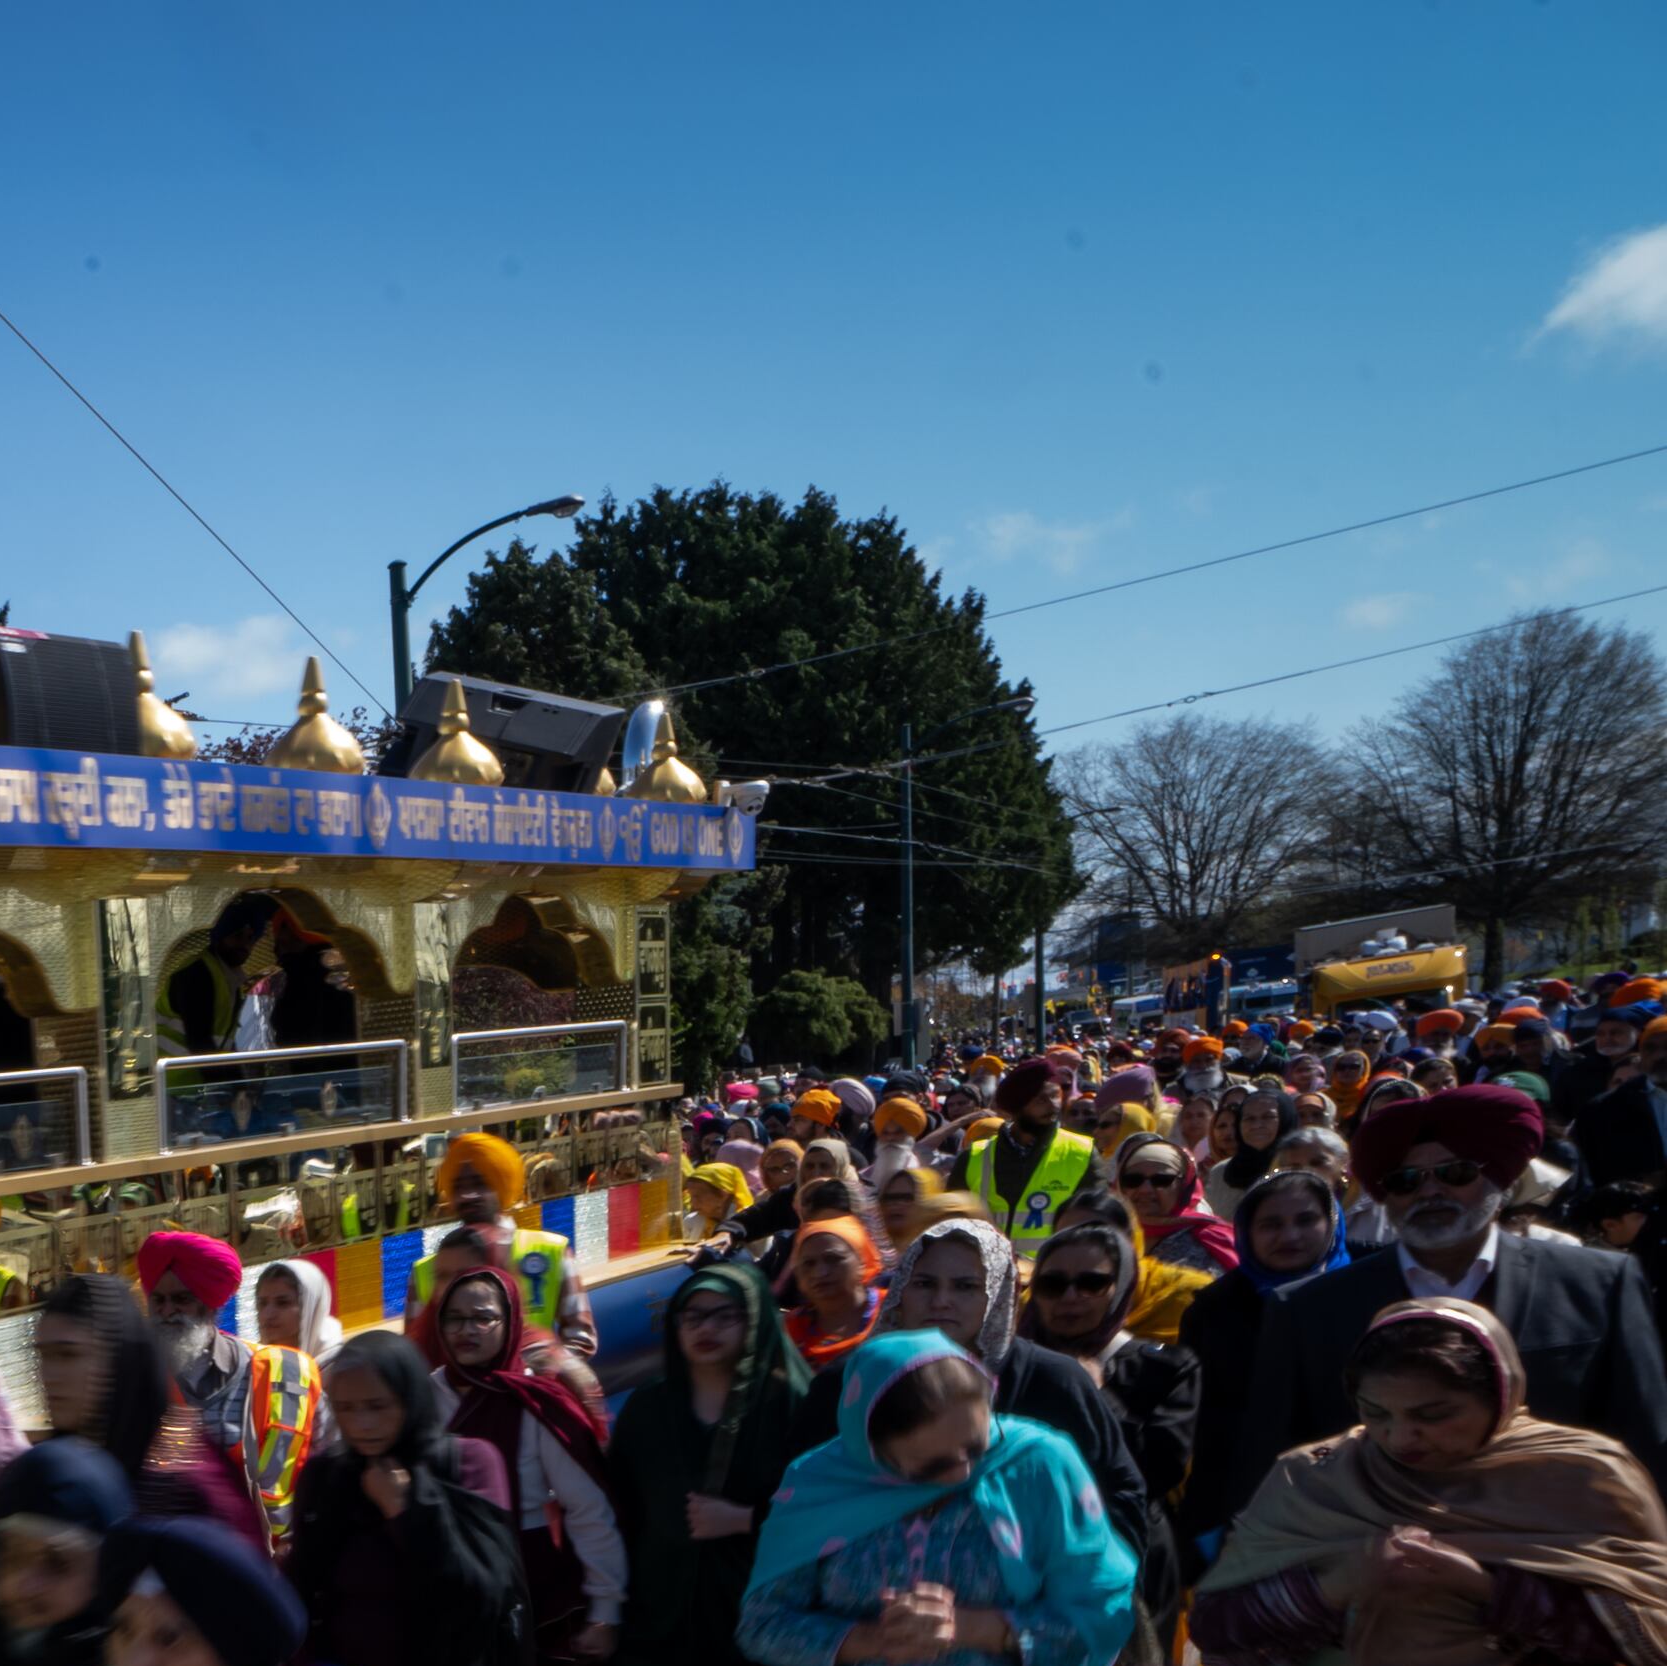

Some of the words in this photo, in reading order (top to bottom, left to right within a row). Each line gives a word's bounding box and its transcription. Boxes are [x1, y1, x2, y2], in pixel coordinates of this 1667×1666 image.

[651, 812, 679, 855] GOD
[682, 815, 695, 855] IS
[698, 816, 724, 857] ONE
